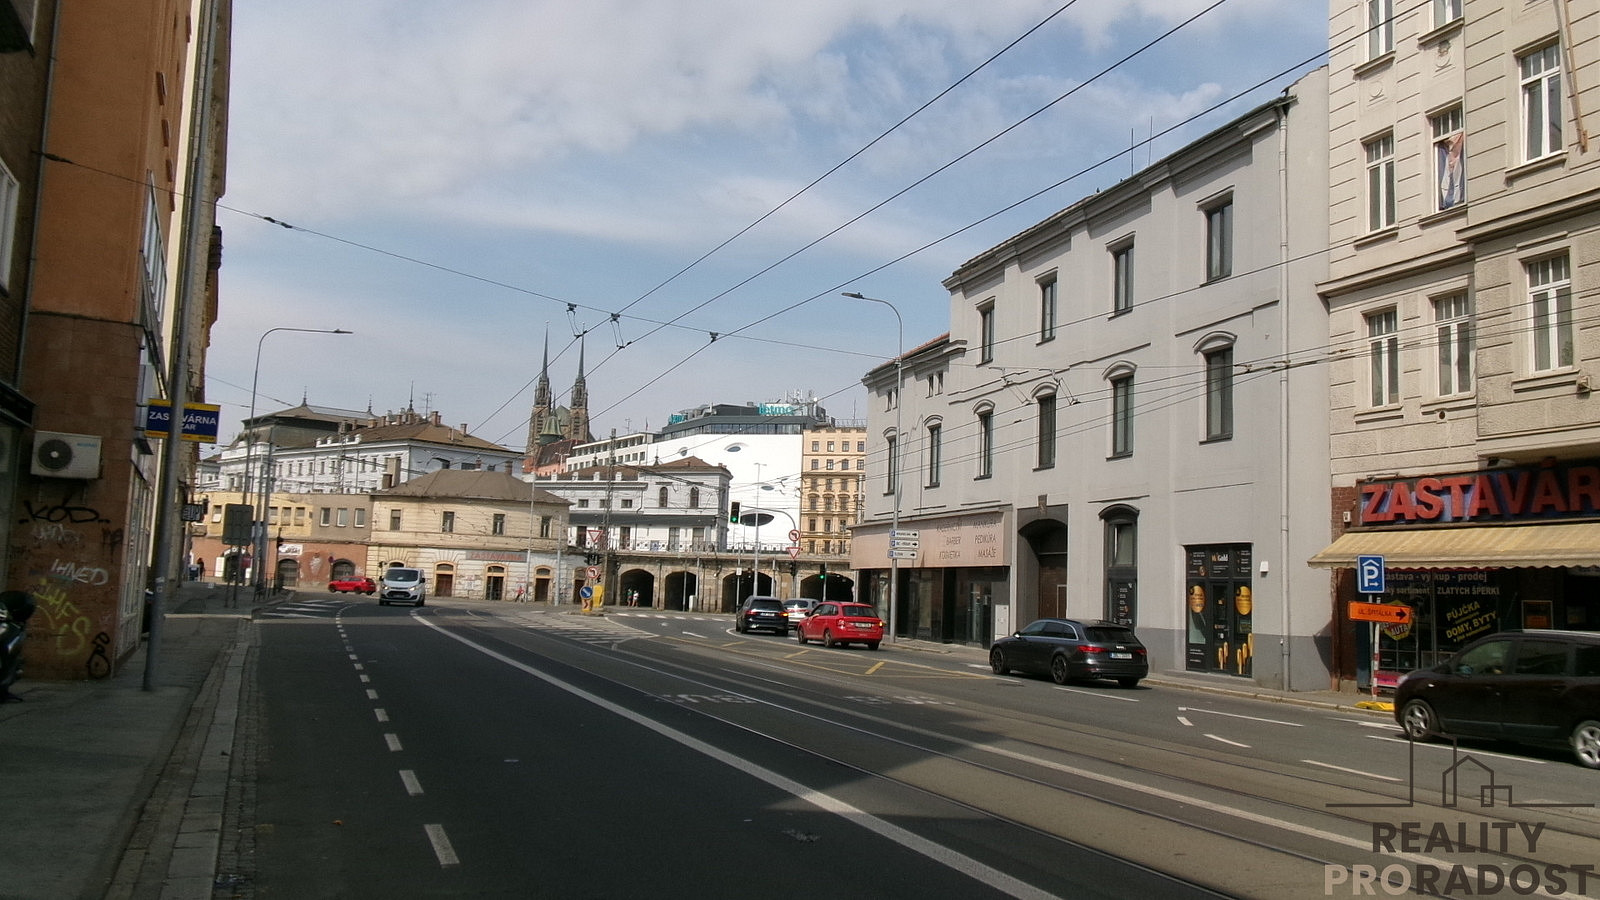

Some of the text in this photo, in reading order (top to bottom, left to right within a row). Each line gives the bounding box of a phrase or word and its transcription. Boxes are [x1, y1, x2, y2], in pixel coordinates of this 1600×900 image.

[149, 411, 217, 425] ZASVÁRNA
[1362, 456, 1600, 522] ZASTAVÁR
[1385, 572, 1414, 581] ástava
[1458, 572, 1487, 582] prodej
[1472, 610, 1497, 628] BYTY
